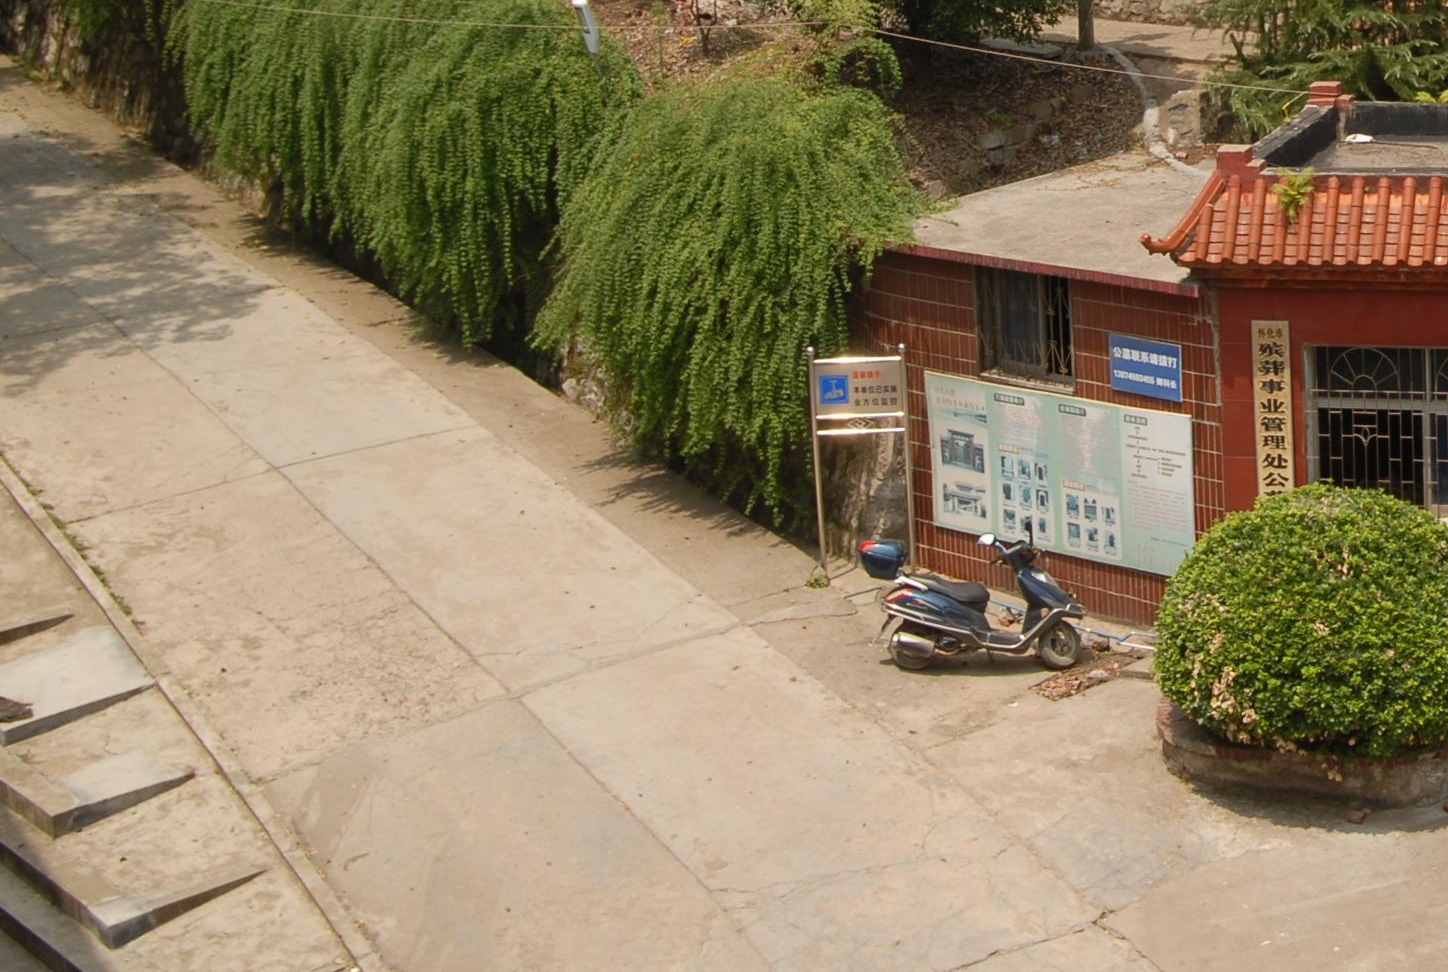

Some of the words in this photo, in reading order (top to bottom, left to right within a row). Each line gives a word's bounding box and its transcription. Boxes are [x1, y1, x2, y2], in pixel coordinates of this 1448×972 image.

[1258, 341, 1289, 496] 殡葬事业管理处公
